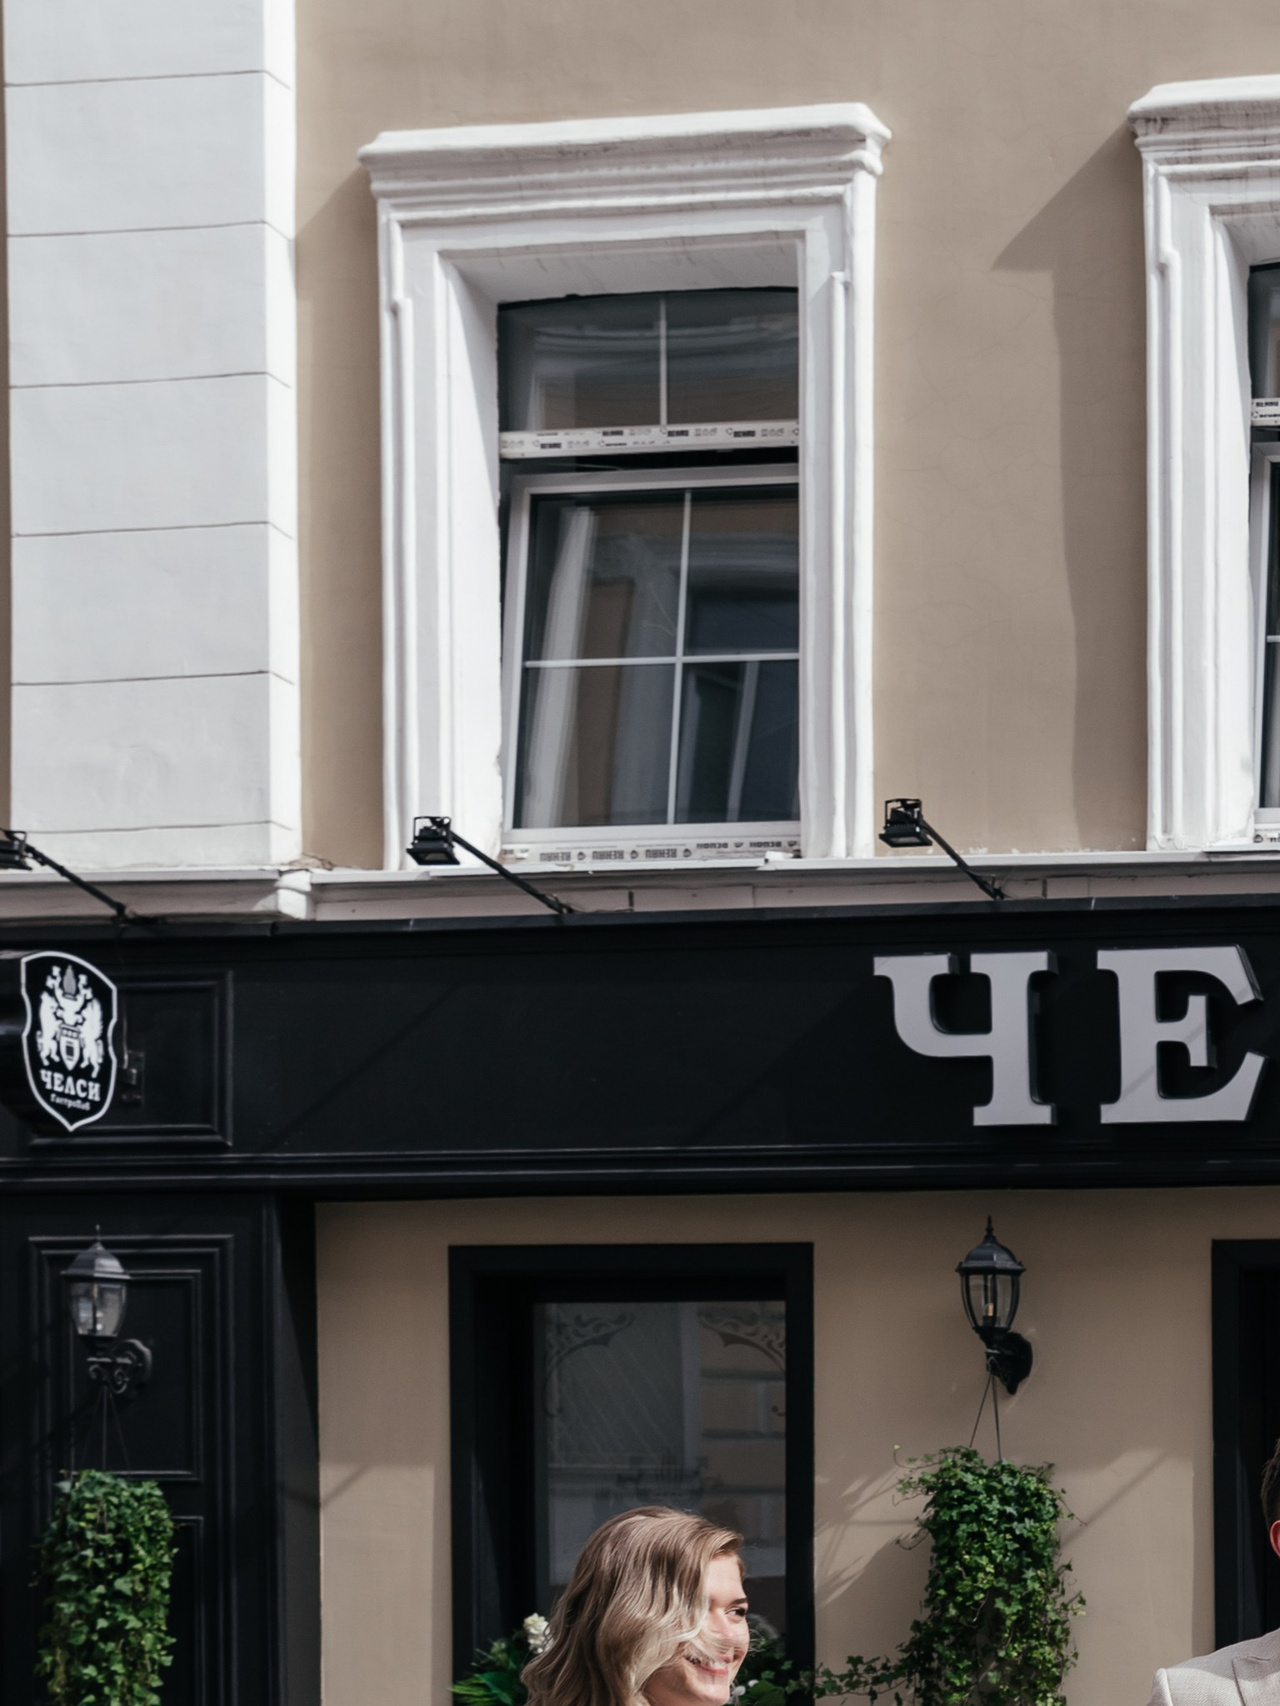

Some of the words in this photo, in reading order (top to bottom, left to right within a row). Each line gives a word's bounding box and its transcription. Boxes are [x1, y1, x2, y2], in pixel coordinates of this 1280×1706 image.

[540, 851, 571, 862] REHAU
[592, 850, 624, 860] REHAU
[645, 848, 677, 859] REHAU
[40, 1069, 101, 1101] ЧЕЛСИ
